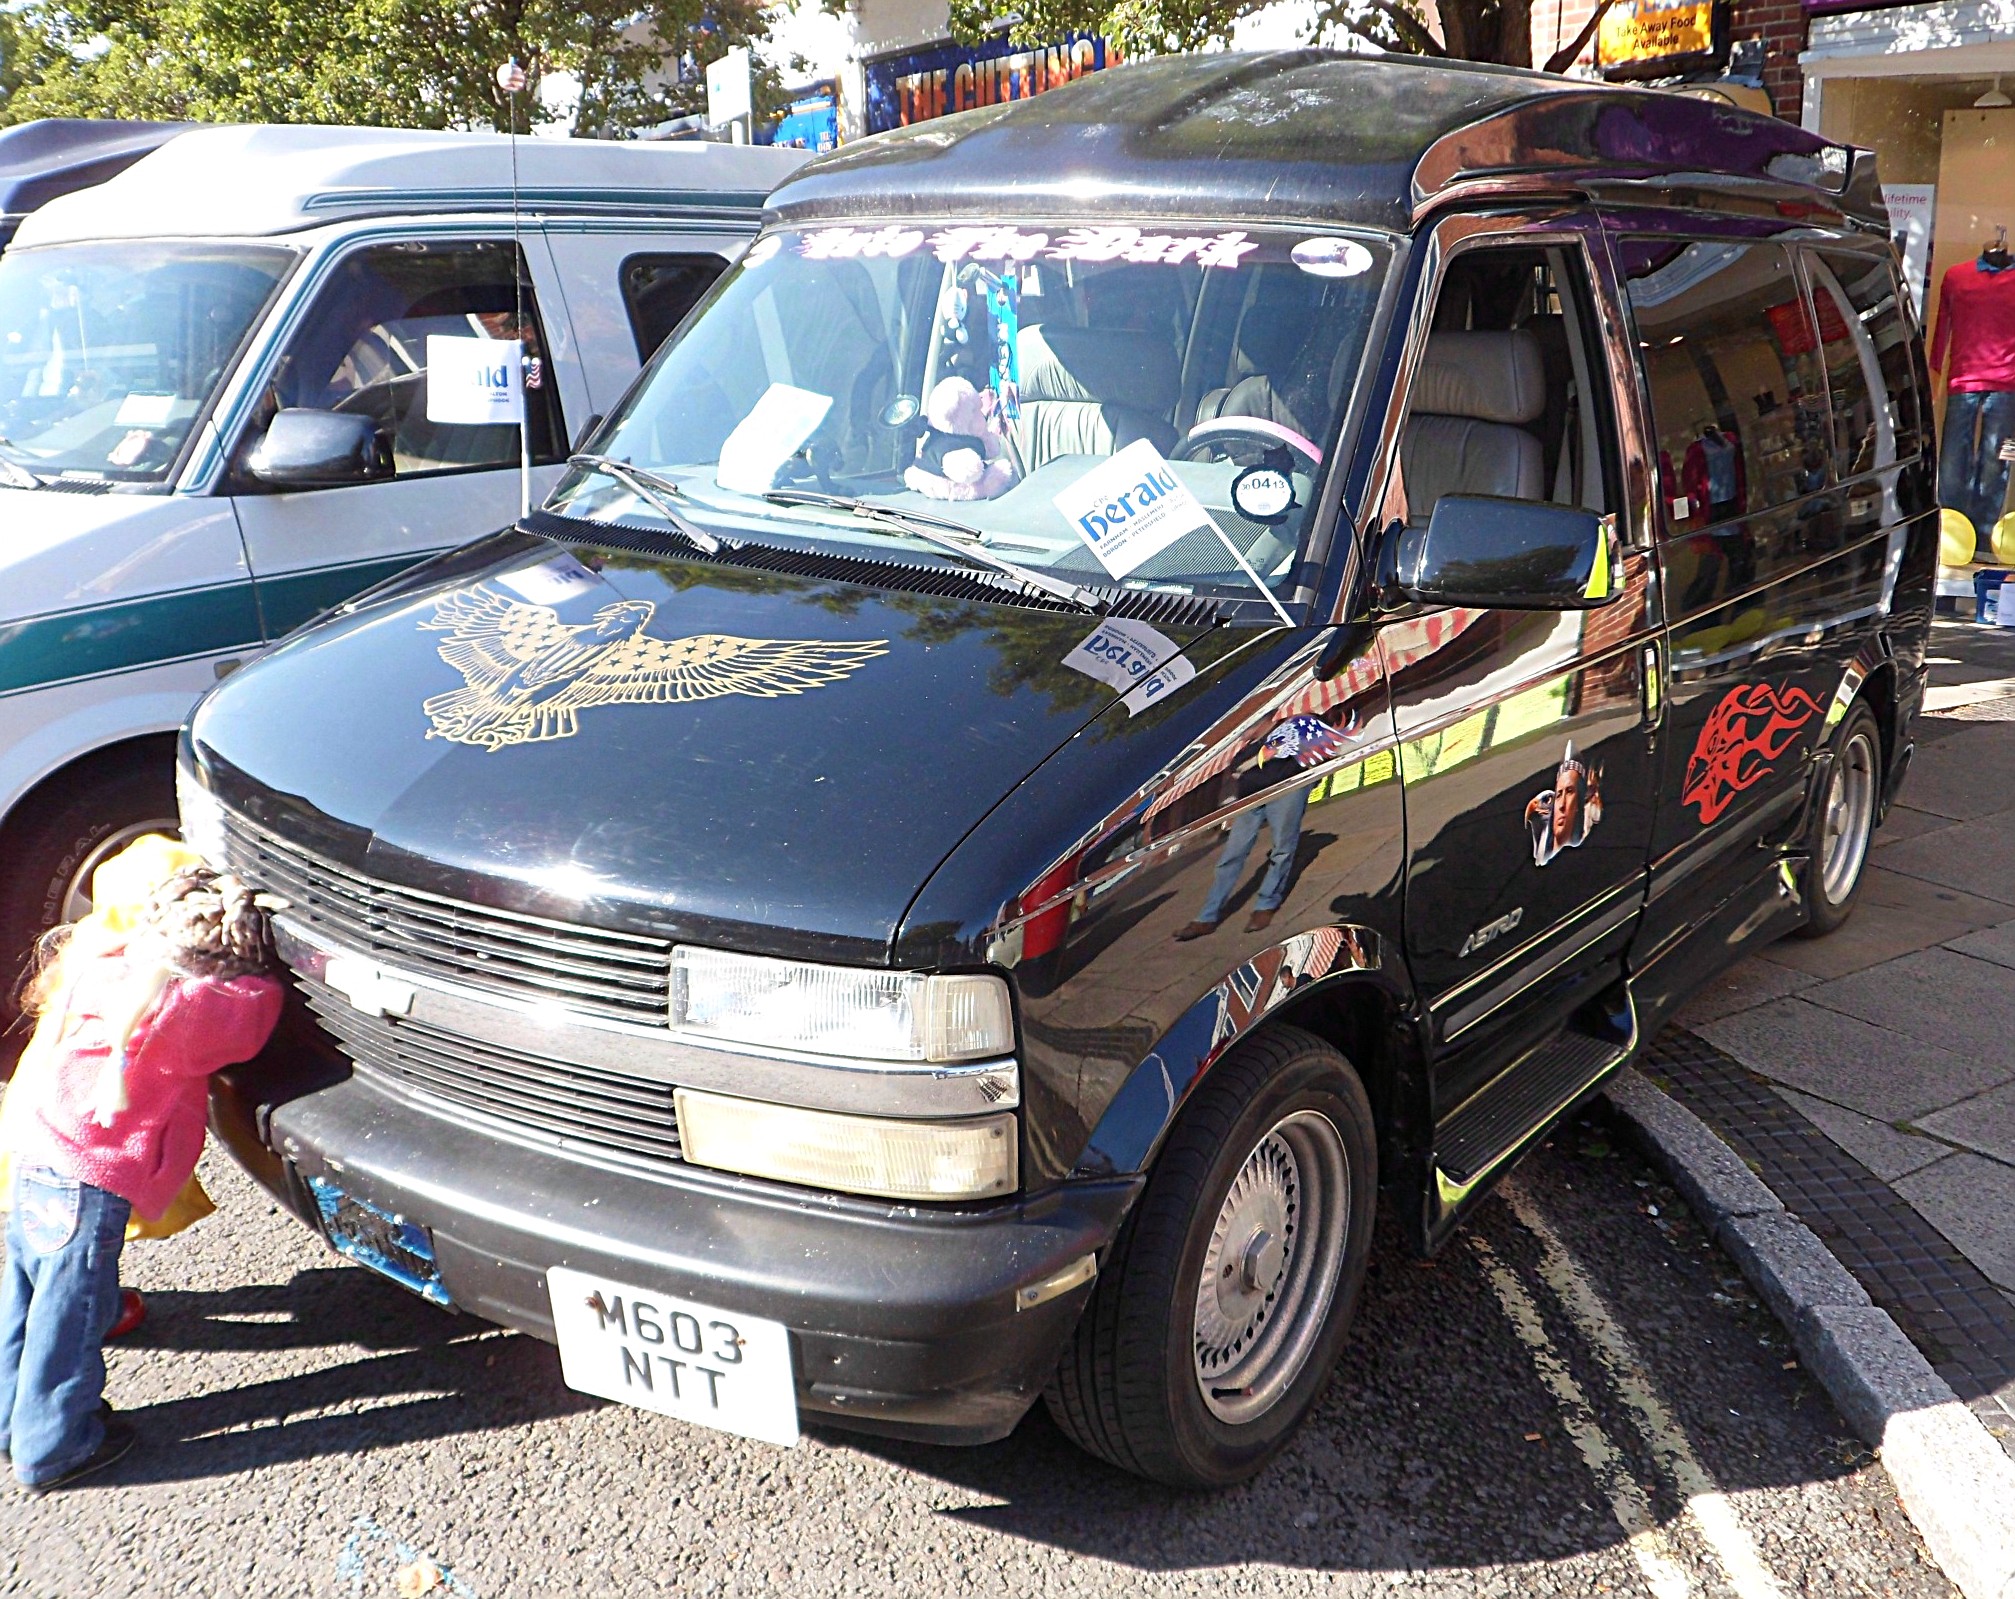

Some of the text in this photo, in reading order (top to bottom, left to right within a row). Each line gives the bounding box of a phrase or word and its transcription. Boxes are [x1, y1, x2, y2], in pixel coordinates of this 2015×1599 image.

[1616, 15, 1697, 38] Take Away Food
[1632, 33, 1679, 51] Available
[896, 68, 947, 127] THE
[953, 38, 1095, 112] CUTTING
[1884, 193, 1928, 205] lifetime
[1043, 226, 1260, 269] Dark
[1251, 477, 1272, 490] 04
[1272, 479, 1285, 489] 13
[1078, 466, 1178, 543] herald
[1099, 528, 1129, 550] FARNHAM
[1102, 539, 1128, 558] BORDON
[1458, 906, 1523, 958] ASTRO
[593, 1290, 744, 1365] M603
[620, 1345, 727, 1411] NTT
